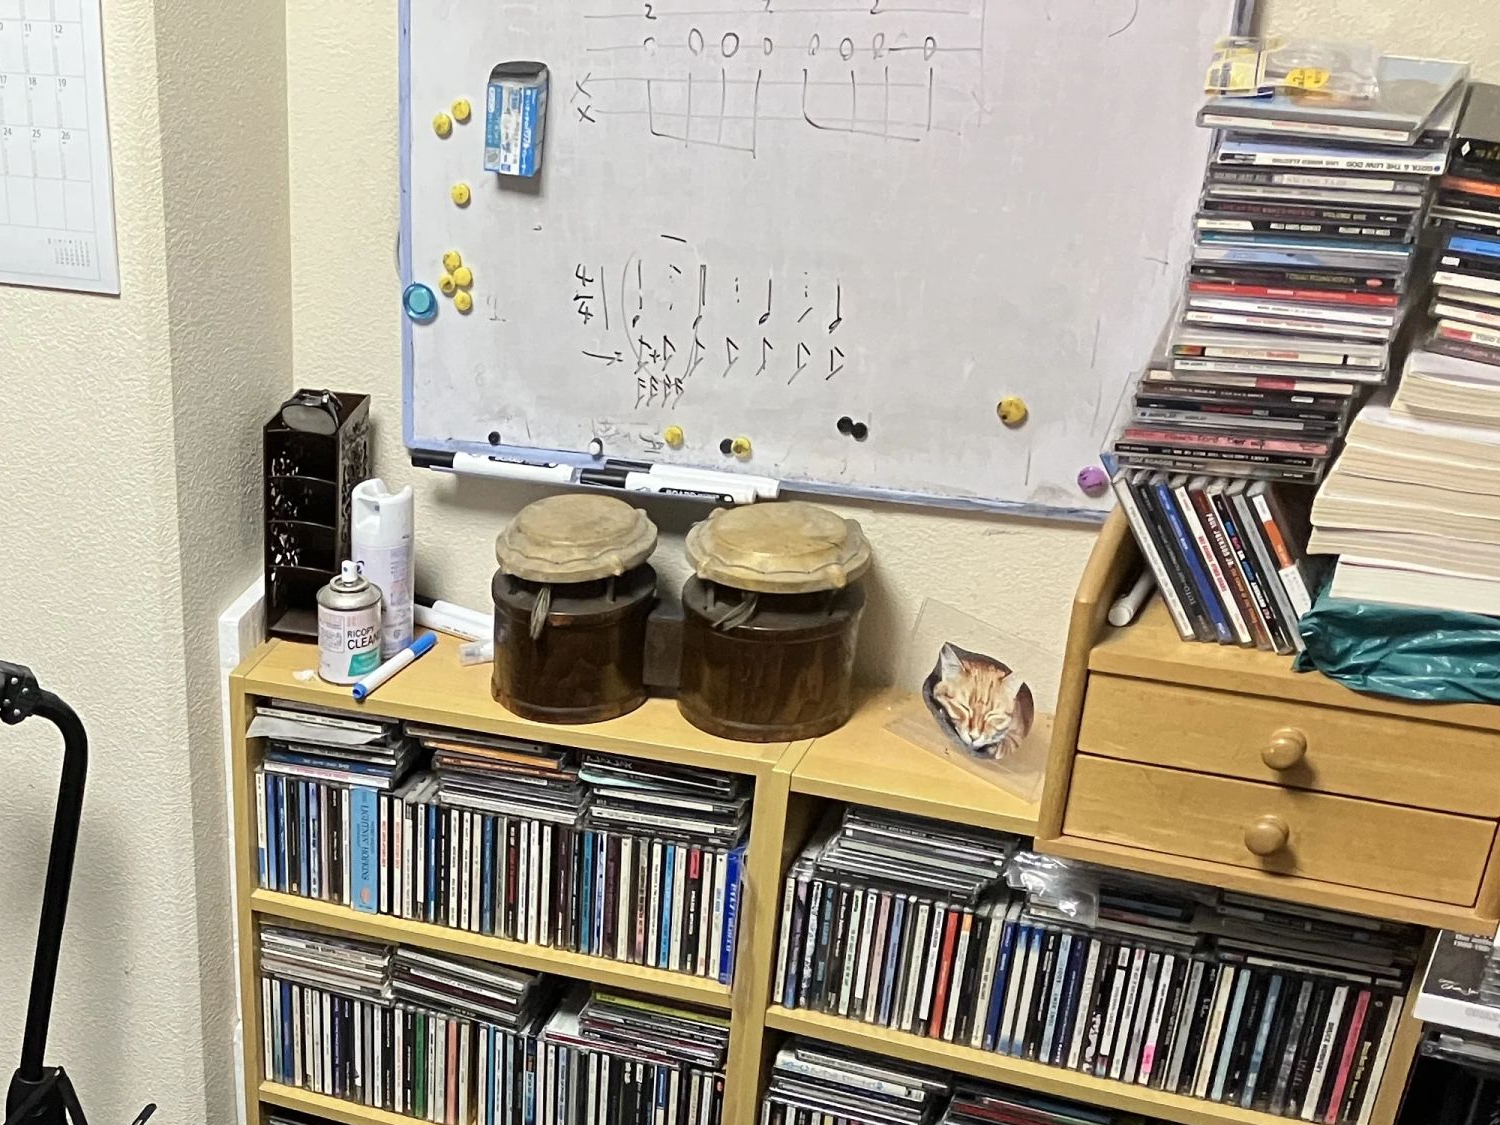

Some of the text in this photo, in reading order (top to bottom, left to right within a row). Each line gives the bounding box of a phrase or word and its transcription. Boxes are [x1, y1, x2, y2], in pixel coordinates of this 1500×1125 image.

[24, 23, 32, 32] 11
[54, 24, 63, 34] 12
[0, 75, 7, 84] 17
[28, 77, 36, 86] 18
[58, 78, 66, 88] 19
[3, 127, 12, 136] 24
[32, 129, 41, 138] 25
[61, 130, 70, 140] 26
[575, 263, 594, 287] 4
[665, 489, 696, 497] BOARD
[1204, 512, 1219, 529] PAUL
[1211, 528, 1232, 558] JACKSON
[347, 626, 374, 638] RICOPY
[360, 846, 371, 881] HOPKINS
[1315, 1022, 1335, 1074] BRUCE HORNSBY
